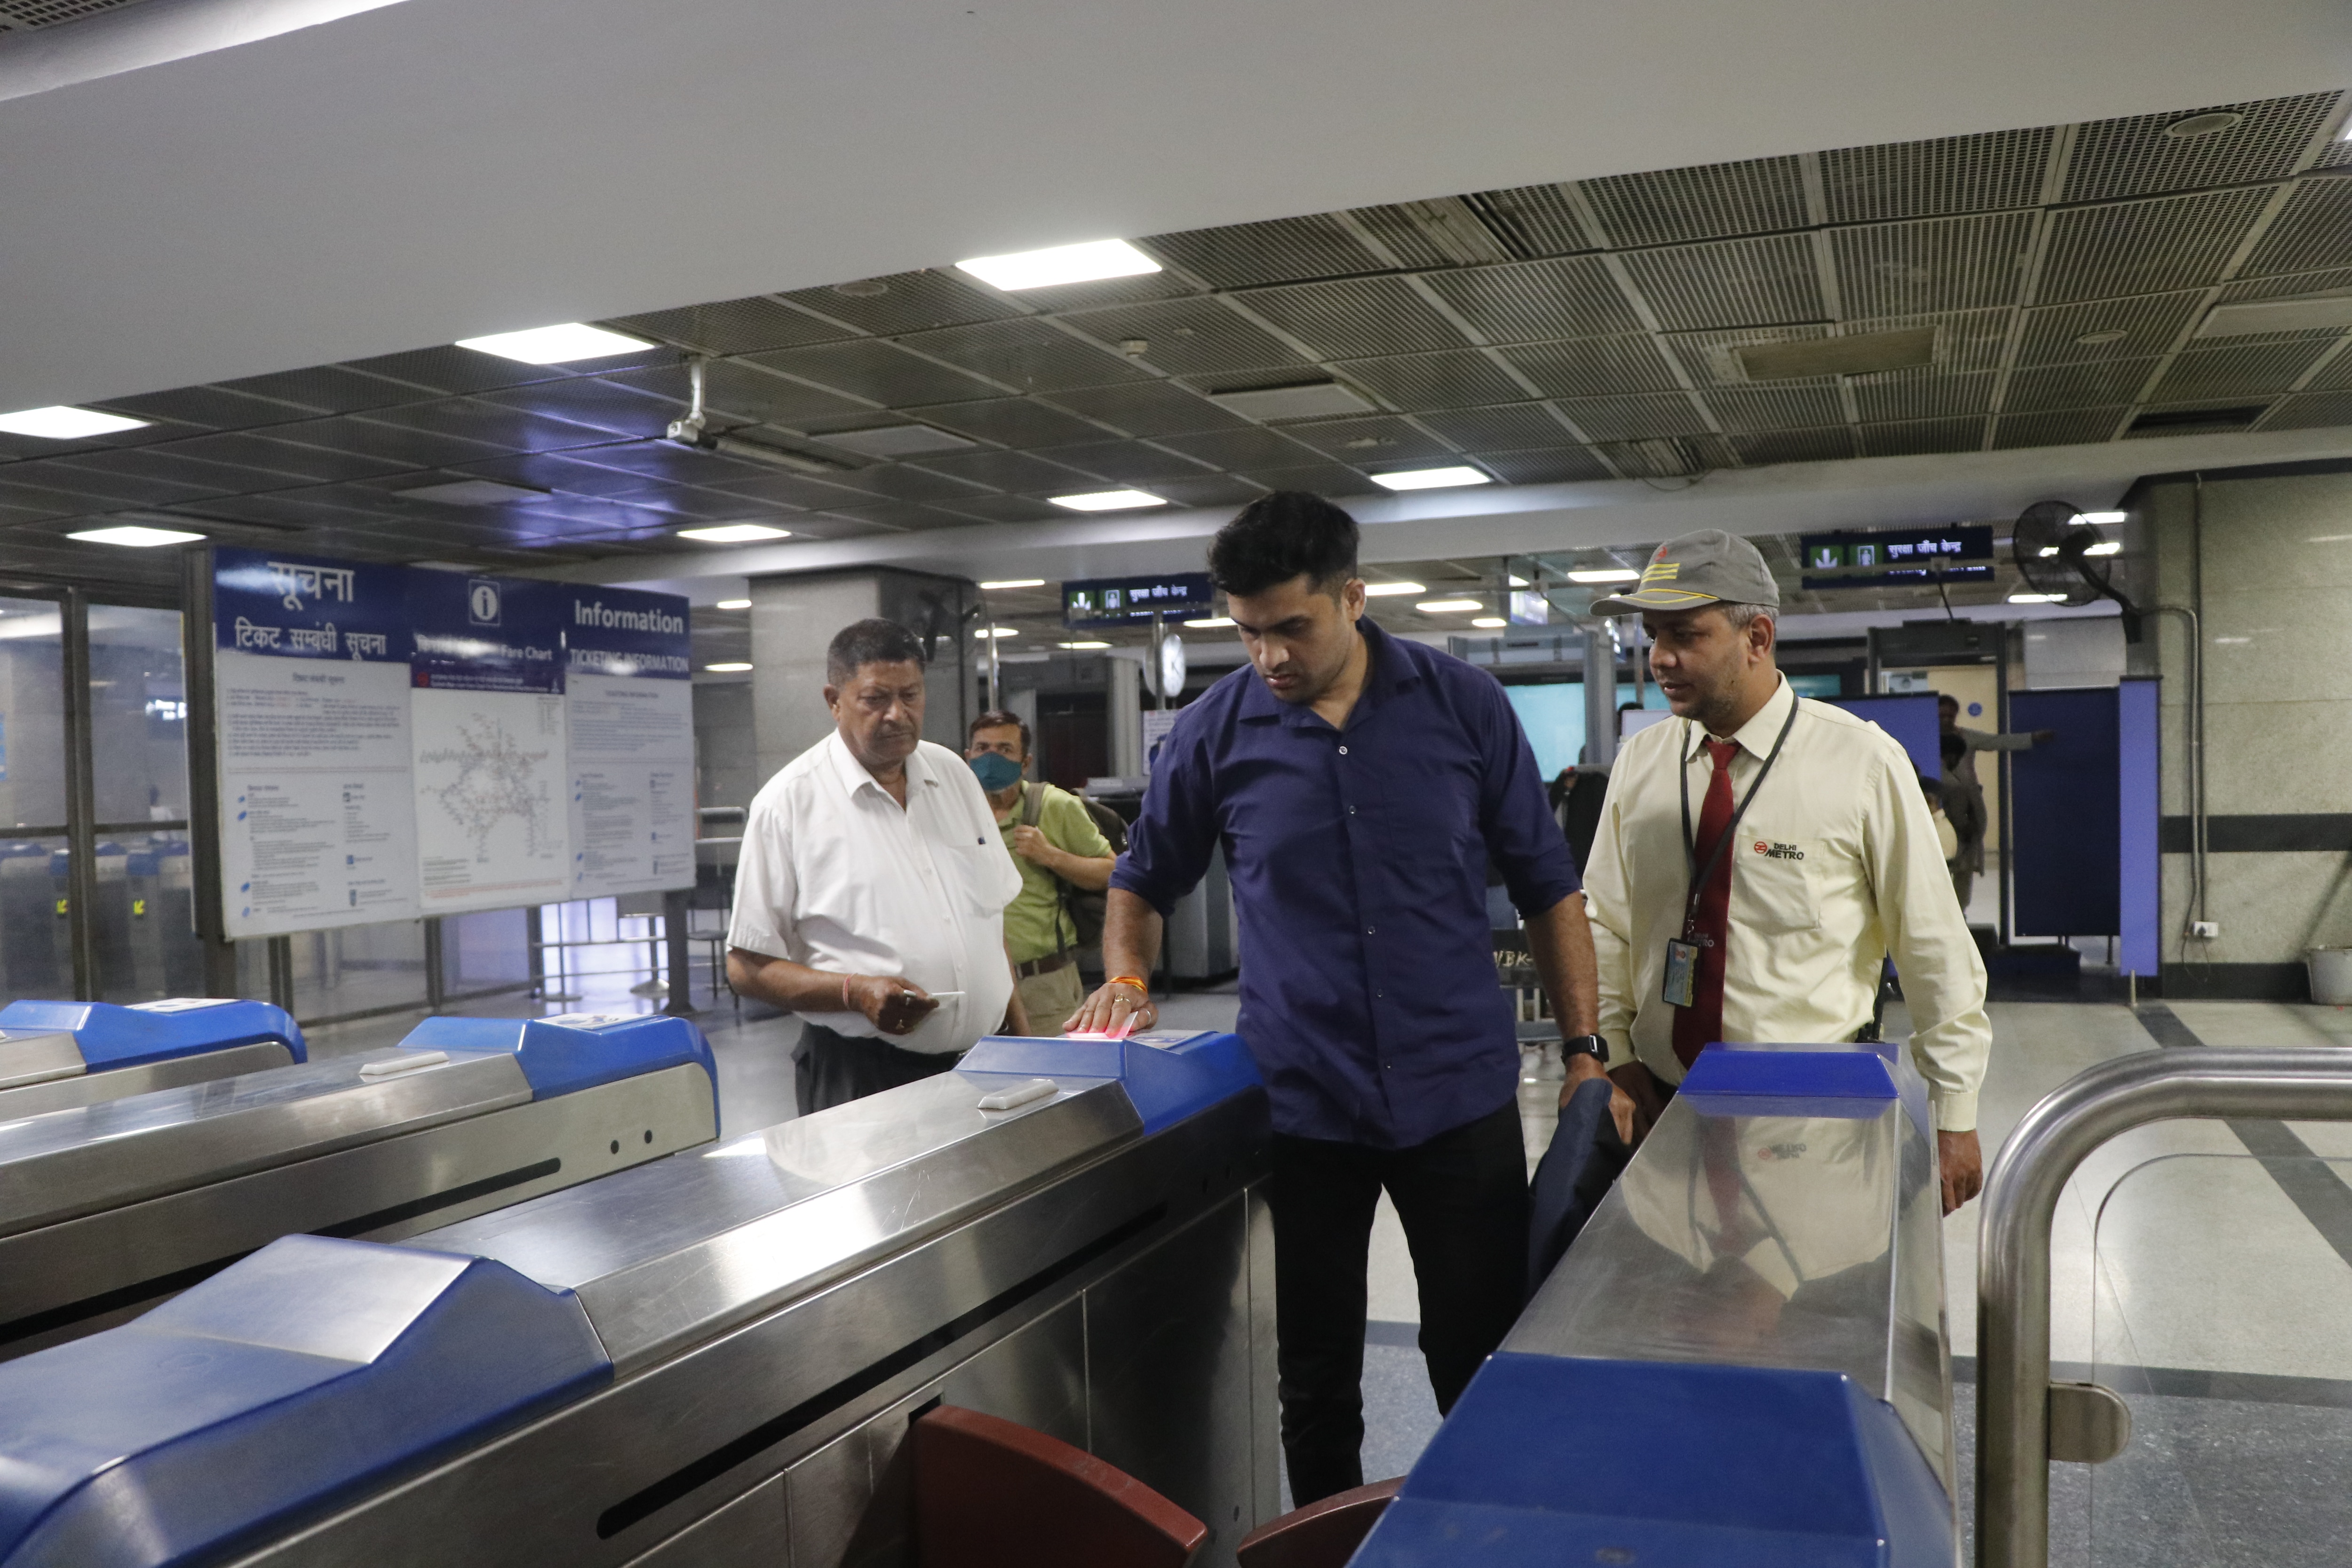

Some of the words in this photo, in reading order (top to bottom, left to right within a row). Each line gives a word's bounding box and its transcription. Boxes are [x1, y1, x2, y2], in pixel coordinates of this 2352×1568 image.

[267, 561, 355, 611] सूचना
[574, 599, 683, 634] Information
[235, 616, 281, 649] टिकट
[344, 632, 387, 660] सूचना
[1764, 849, 1804, 860] METRO
